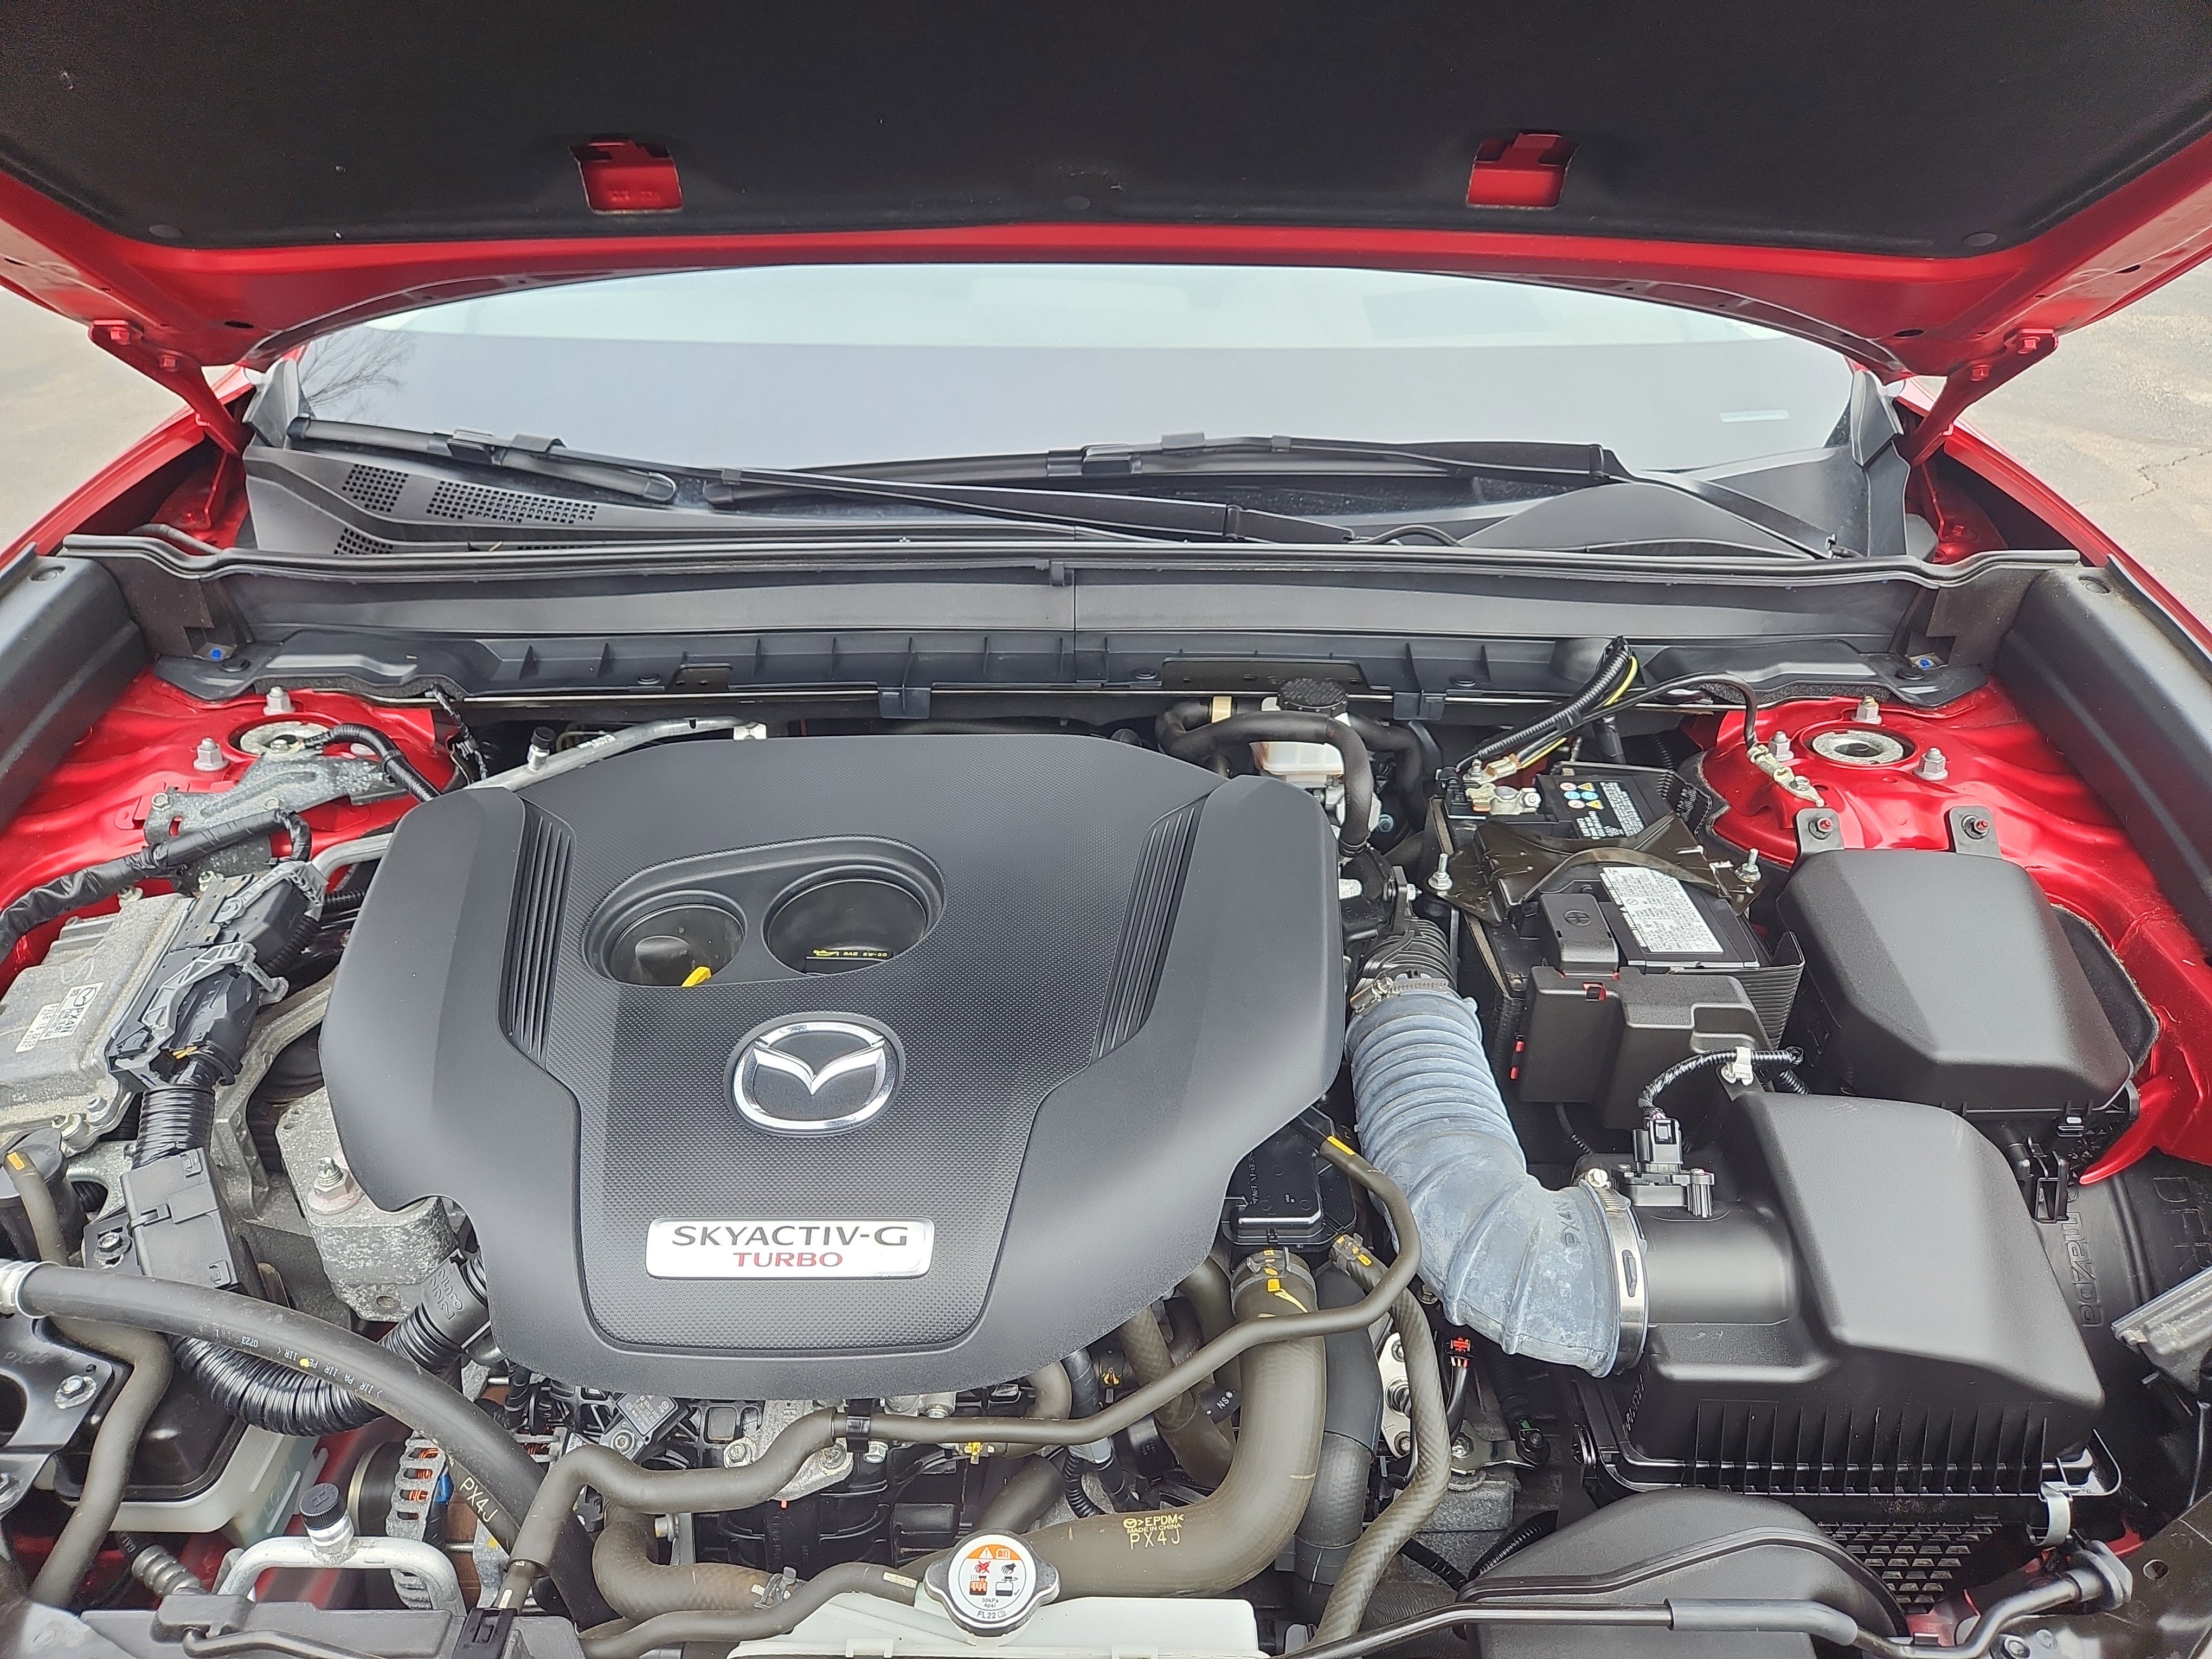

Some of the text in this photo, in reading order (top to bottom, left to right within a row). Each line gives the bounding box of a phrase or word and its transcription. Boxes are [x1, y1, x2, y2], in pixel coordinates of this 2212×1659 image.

[671, 1225, 908, 1246] SKYACTIV-G
[735, 1252, 843, 1268] TURBO
[2060, 1211, 2104, 1328] mazda
[242, 1336, 259, 1348] 0723
[459, 1477, 499, 1522] PX4J
[1158, 1522, 1182, 1531] CHINA
[1130, 1528, 1180, 1549] PX4J
[977, 1611, 996, 1619] FL22
